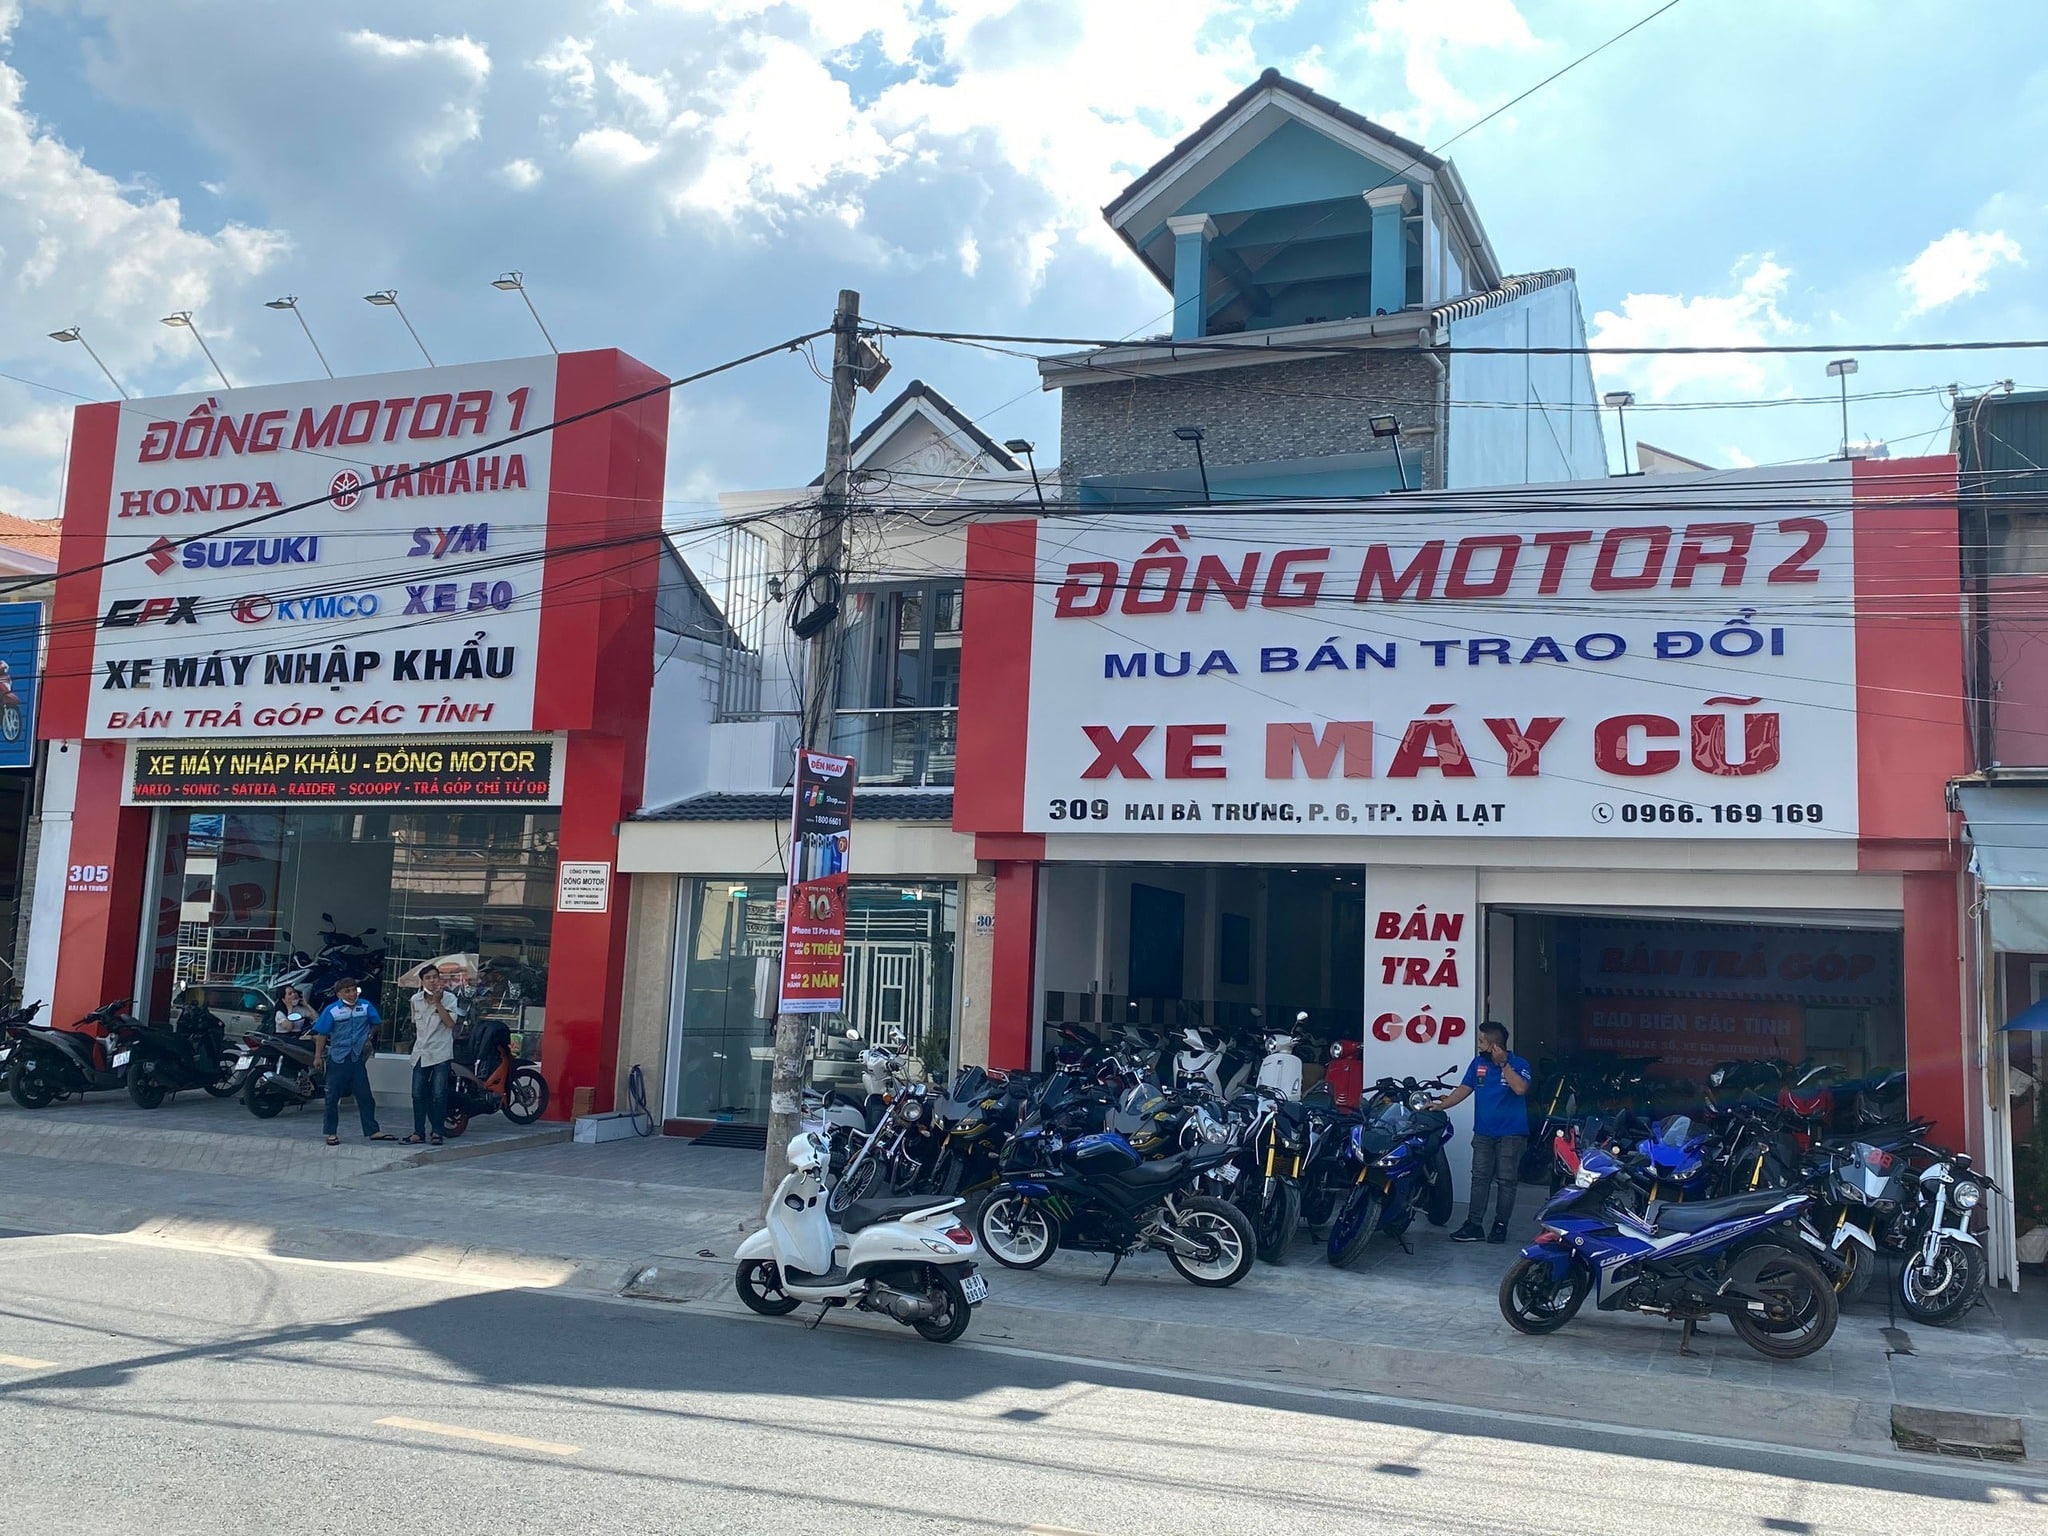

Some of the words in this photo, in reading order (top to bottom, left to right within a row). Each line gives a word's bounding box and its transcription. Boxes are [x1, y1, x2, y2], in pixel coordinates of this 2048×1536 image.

[138, 397, 288, 463] ĐỒNG
[291, 389, 493, 450] MOTOR
[507, 386, 530, 432] 1
[371, 453, 527, 499] YAMAHA
[118, 481, 283, 518] HONDA
[182, 535, 318, 569] SUZUKI
[406, 522, 489, 560] SYM
[1054, 524, 1331, 619] ĐỒNG
[1353, 522, 1755, 604] MOTOR
[1767, 517, 1829, 584] 2
[102, 596, 201, 628] GPX
[277, 593, 379, 621] KYMCO
[402, 583, 457, 616] XE
[467, 580, 513, 612] 50
[1104, 649, 1239, 680] MUA
[1260, 636, 1397, 674] BÁN
[1419, 633, 1628, 668] TRAO
[1653, 607, 1785, 660] ĐỔI
[102, 659, 153, 690] XE
[163, 650, 254, 688] MÁY
[264, 644, 381, 692] NHẬP
[392, 631, 515, 682] KHẨU
[107, 706, 173, 730] BÁN
[184, 702, 243, 728] TRẢ
[253, 702, 324, 727] GÓP
[334, 700, 406, 725] CÁC
[417, 696, 495, 724] TỈNH
[1080, 722, 1228, 780] XE
[1265, 703, 1566, 780] MÁY
[1593, 695, 1780, 778] CŨ
[148, 755, 175, 776] XE
[180, 750, 227, 776] MÁY
[375, 746, 444, 774] ĐỒNG
[449, 750, 536, 773] MOTOR
[826, 763, 844, 773] NGAY
[134, 783, 171, 796] VARIO
[182, 783, 220, 795] SONIC
[231, 783, 277, 796] SATRIA
[288, 782, 336, 795] RAIDER
[349, 782, 402, 795] SCOOPY
[443, 777, 472, 795] GÓP
[1048, 798, 1109, 821] 309
[1125, 802, 1164, 821] HAI
[1171, 799, 1202, 821] BÀ
[1212, 802, 1302, 824] TRƯNG,
[1308, 803, 1329, 821] P.
[1334, 803, 1358, 824] 6,
[1365, 803, 1402, 822] TP.
[1411, 799, 1448, 823] ĐÀ
[1456, 803, 1506, 827] LẠT
[1621, 803, 1703, 824] 0966.
[1710, 803, 1763, 824] 169
[1771, 803, 1824, 824] 169
[69, 864, 108, 883] 305
[808, 893, 831, 921] 10
[1374, 903, 1465, 942] BÁN
[803, 943, 810, 956] 6
[811, 940, 842, 960] TRIỆU
[1598, 941, 1685, 978] BÁN
[1778, 945, 1876, 982] GÓP
[801, 973, 810, 988] 2
[811, 970, 839, 988] NĂM
[1381, 948, 1460, 988] TRẢ
[1372, 1004, 1467, 1046] GÓP
[1693, 1014, 1737, 1034] CÁC
